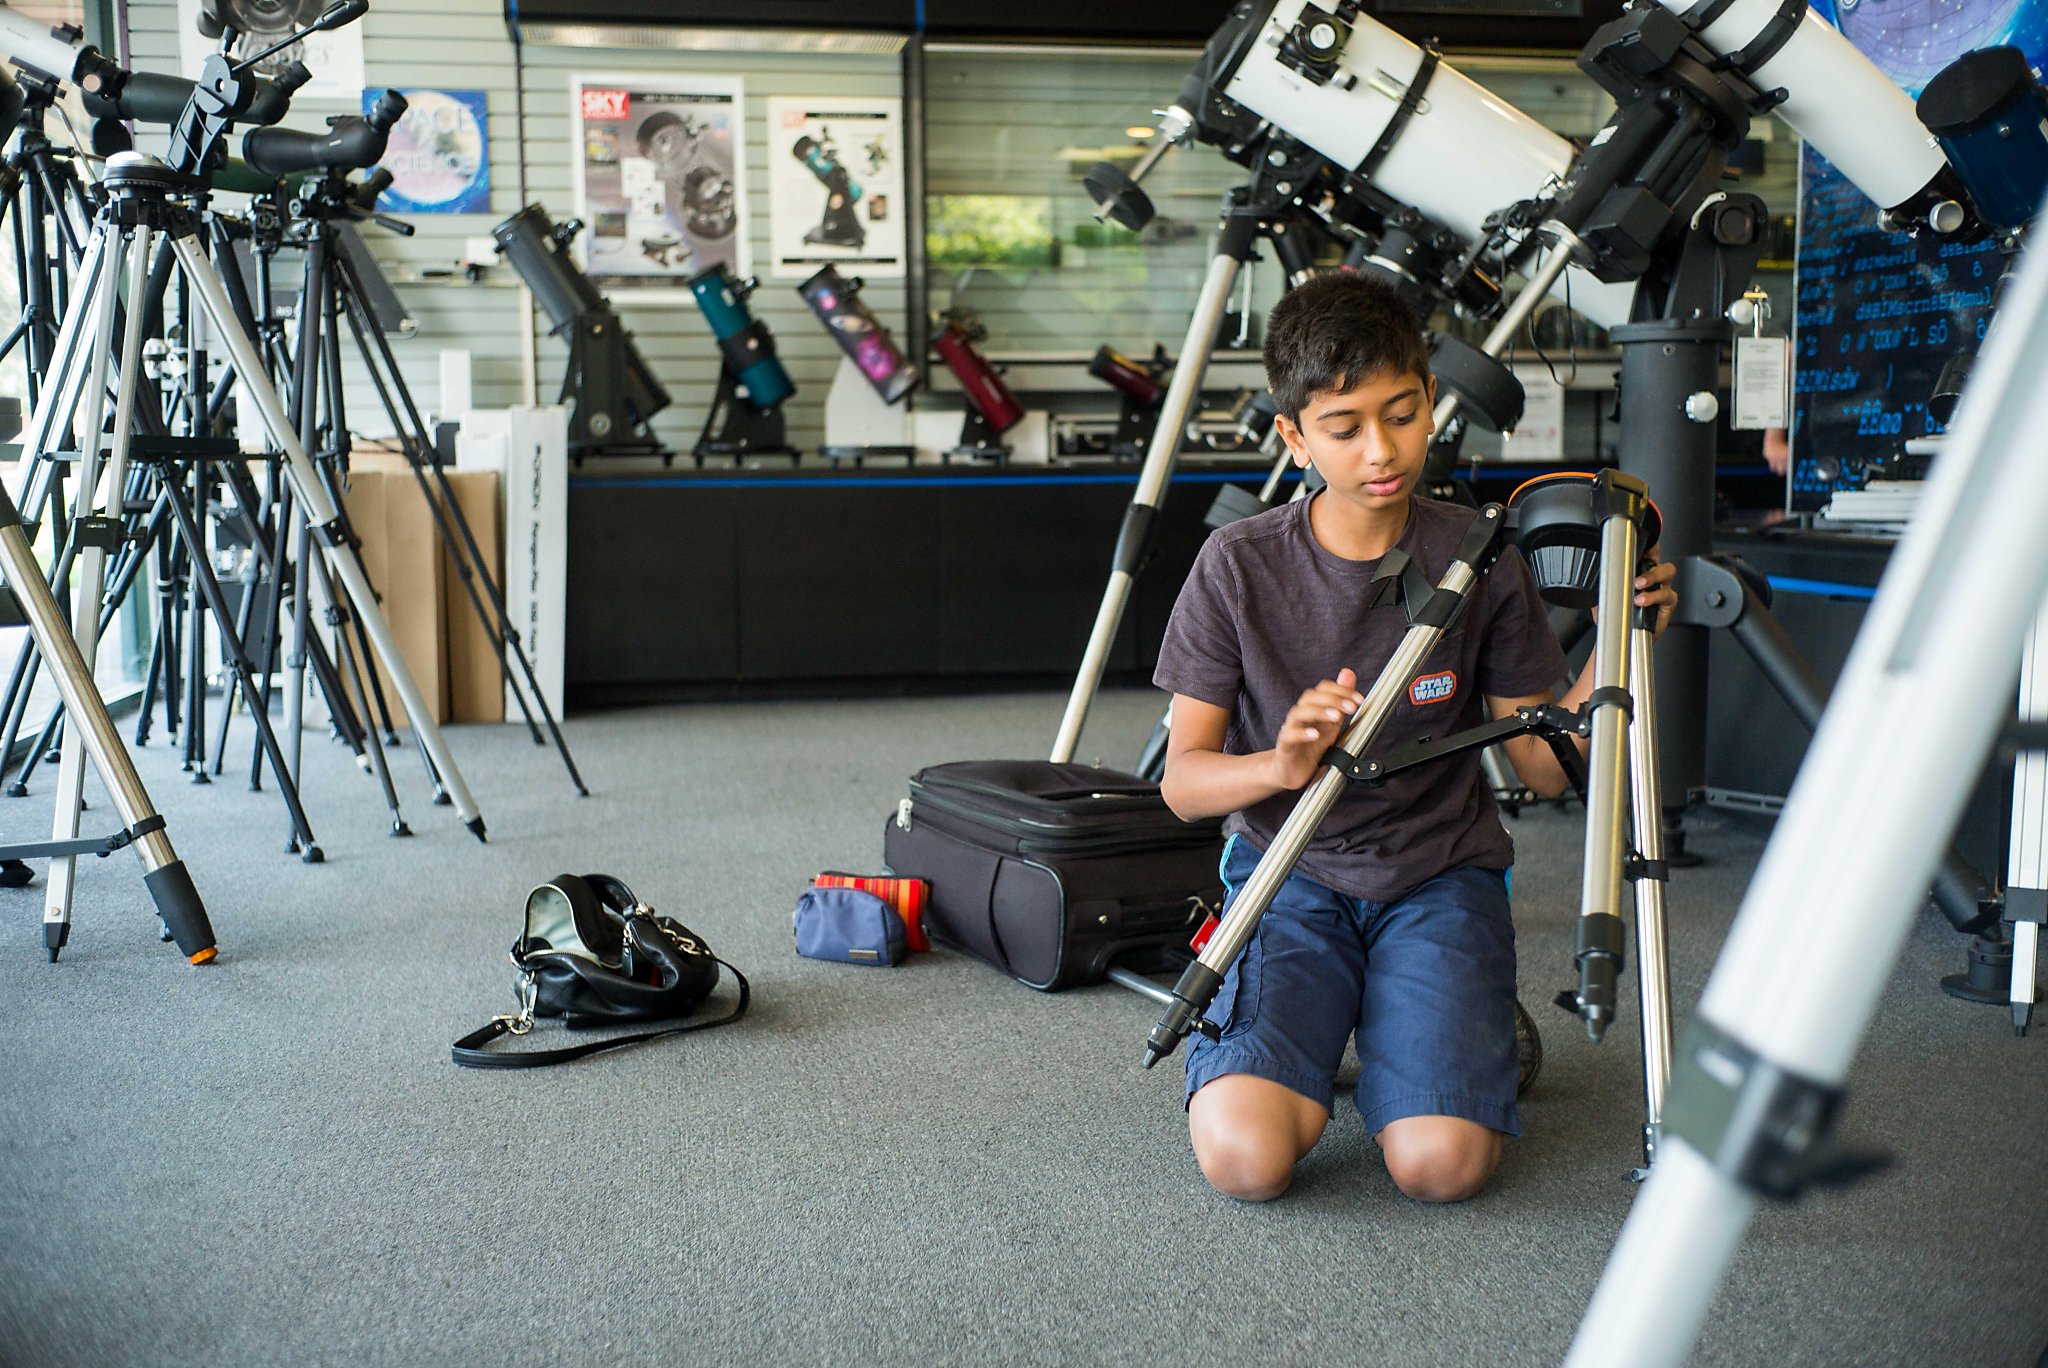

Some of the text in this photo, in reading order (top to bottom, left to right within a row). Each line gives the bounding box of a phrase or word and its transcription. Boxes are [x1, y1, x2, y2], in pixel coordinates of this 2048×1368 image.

[583, 91, 626, 112] SKY
[1414, 675, 1453, 691] STAR
[1415, 684, 1453, 701] WARS
